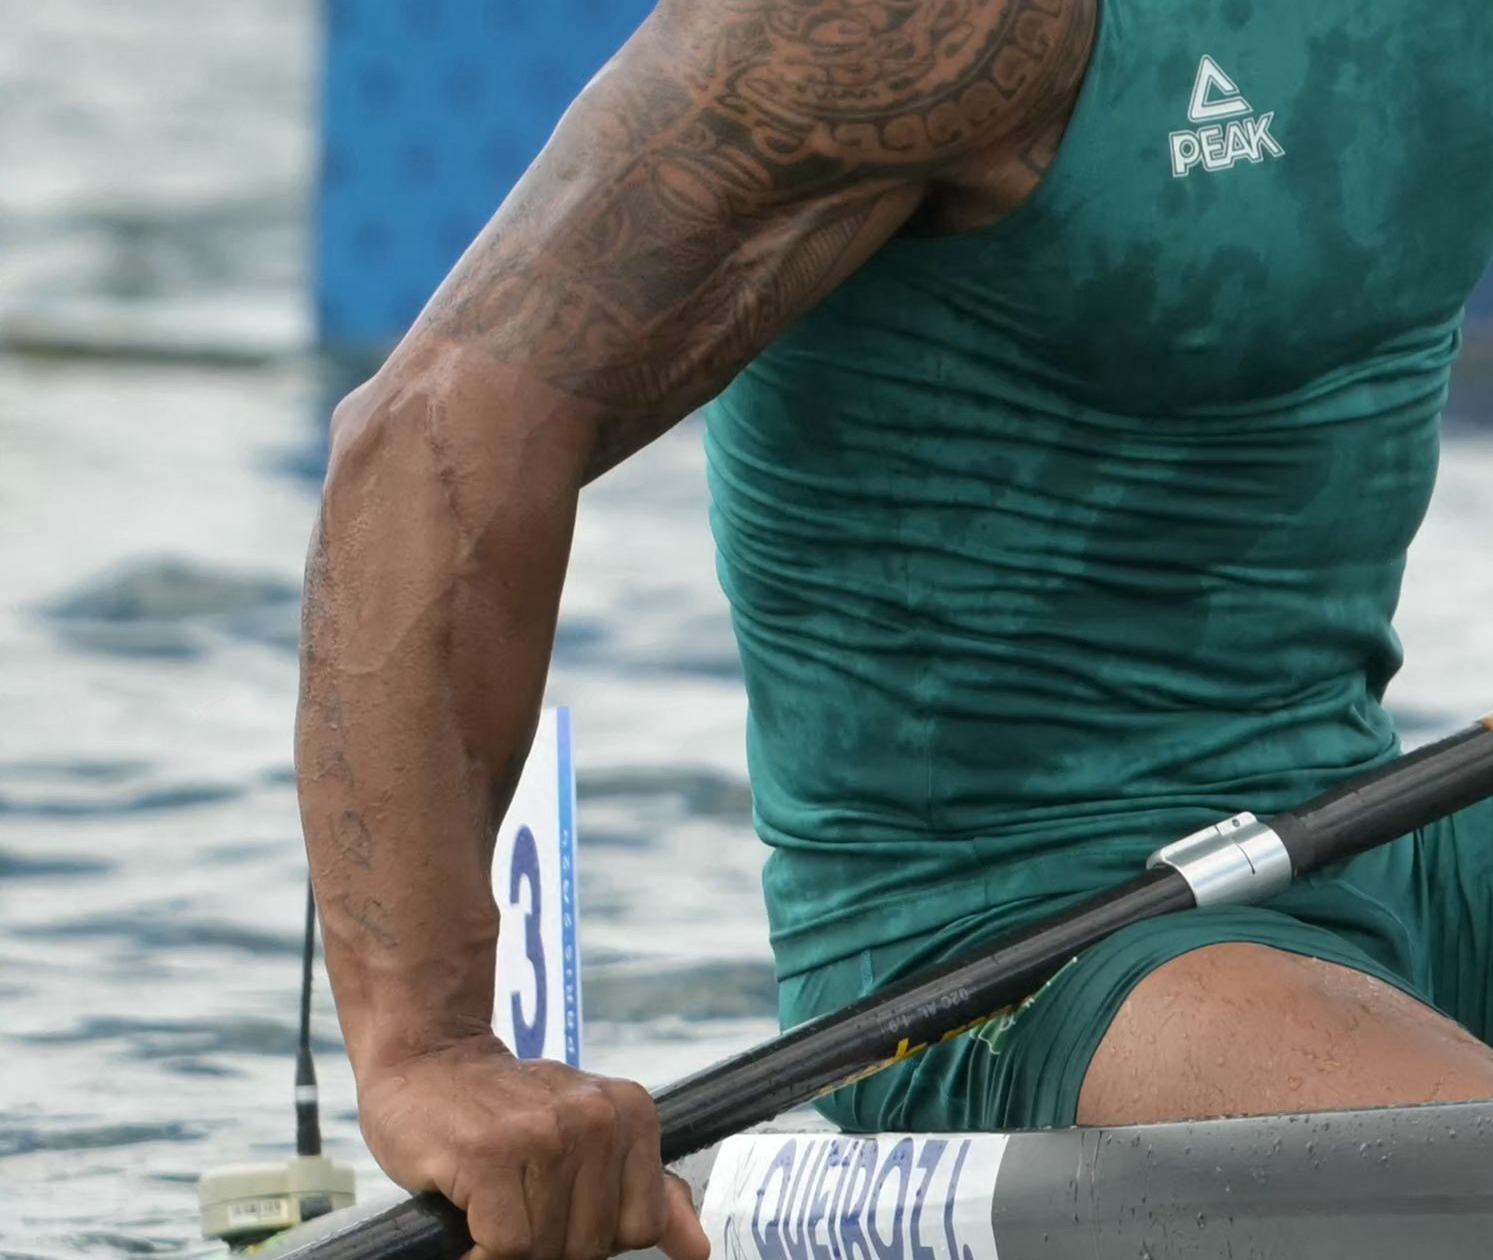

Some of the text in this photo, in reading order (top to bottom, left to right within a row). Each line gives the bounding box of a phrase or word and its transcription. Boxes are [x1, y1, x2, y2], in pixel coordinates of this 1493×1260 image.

[1169, 111, 1286, 177] PEAK
[509, 824, 547, 1060] 3
[751, 1137, 948, 1260] QUEIROZ
